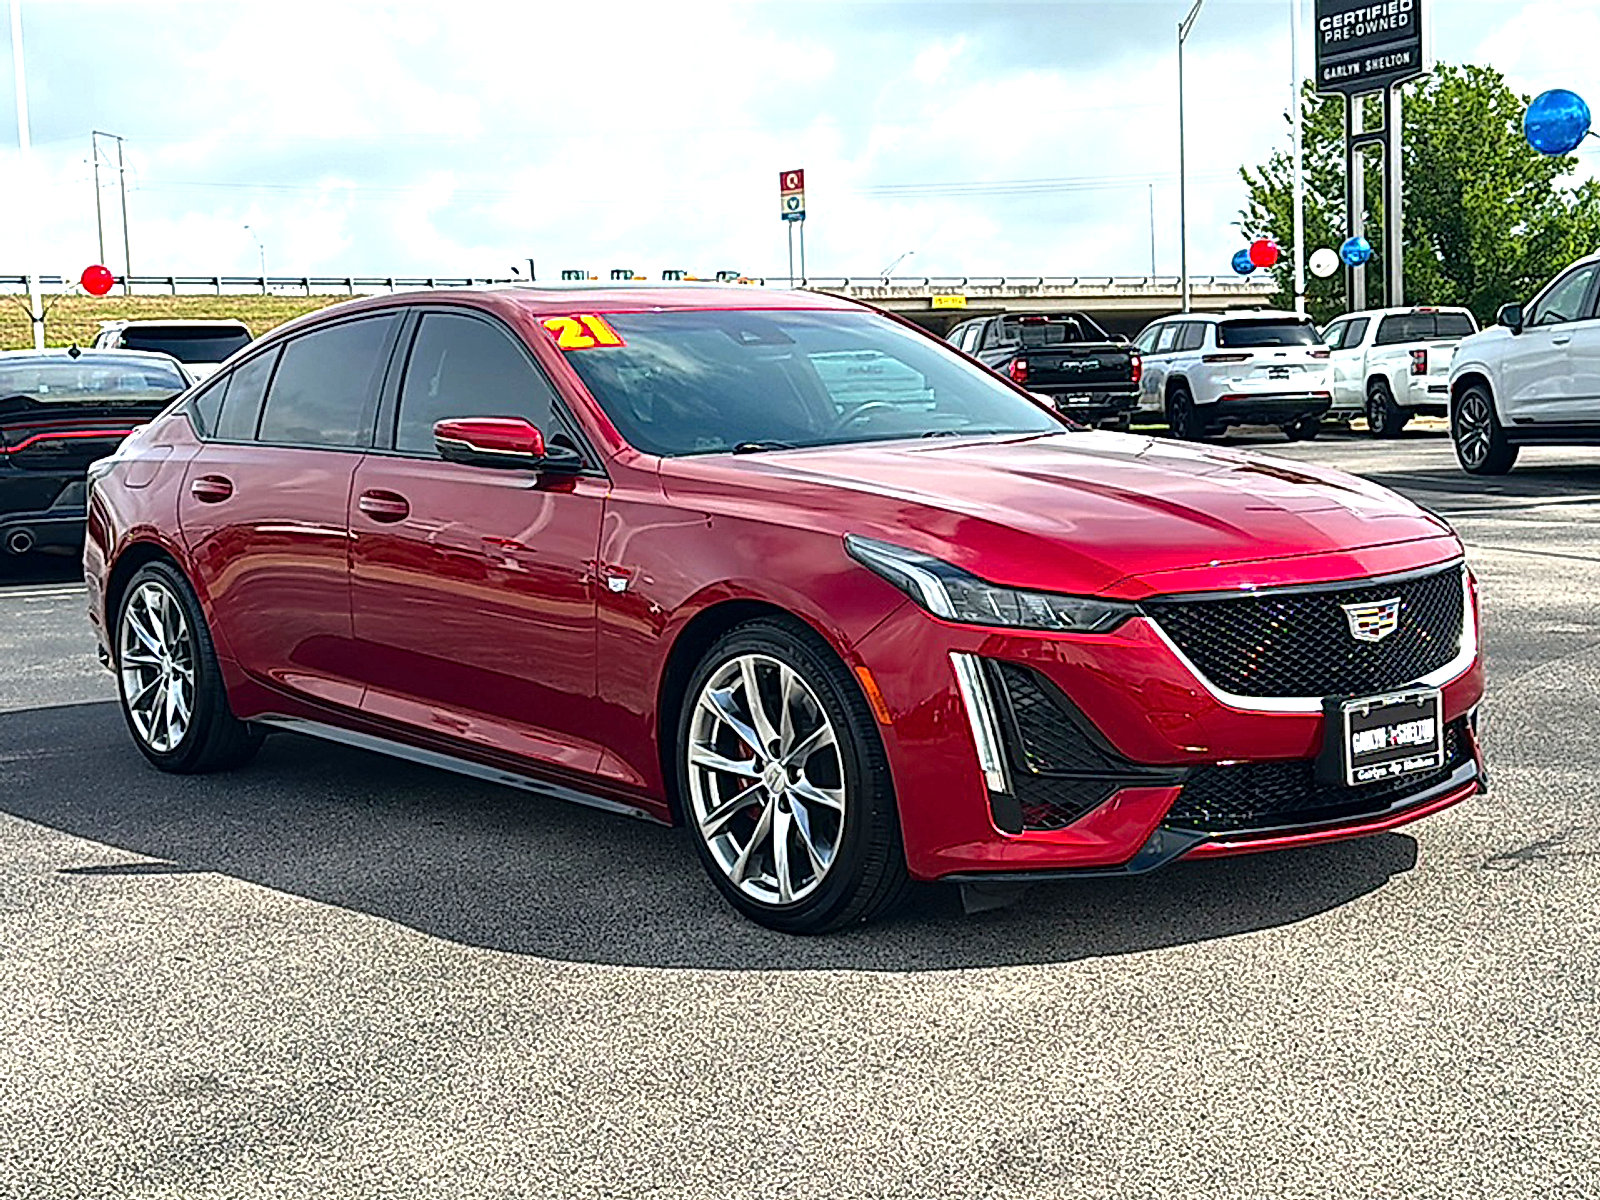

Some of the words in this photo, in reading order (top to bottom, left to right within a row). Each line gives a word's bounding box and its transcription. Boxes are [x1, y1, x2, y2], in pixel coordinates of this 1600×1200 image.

[1320, 0, 1413, 31] CERTIFIED
[1324, 13, 1408, 44] PRE-OWNED
[1323, 62, 1360, 80] GARLYN
[1365, 52, 1410, 72] SHELTON
[543, 314, 621, 348] 21
